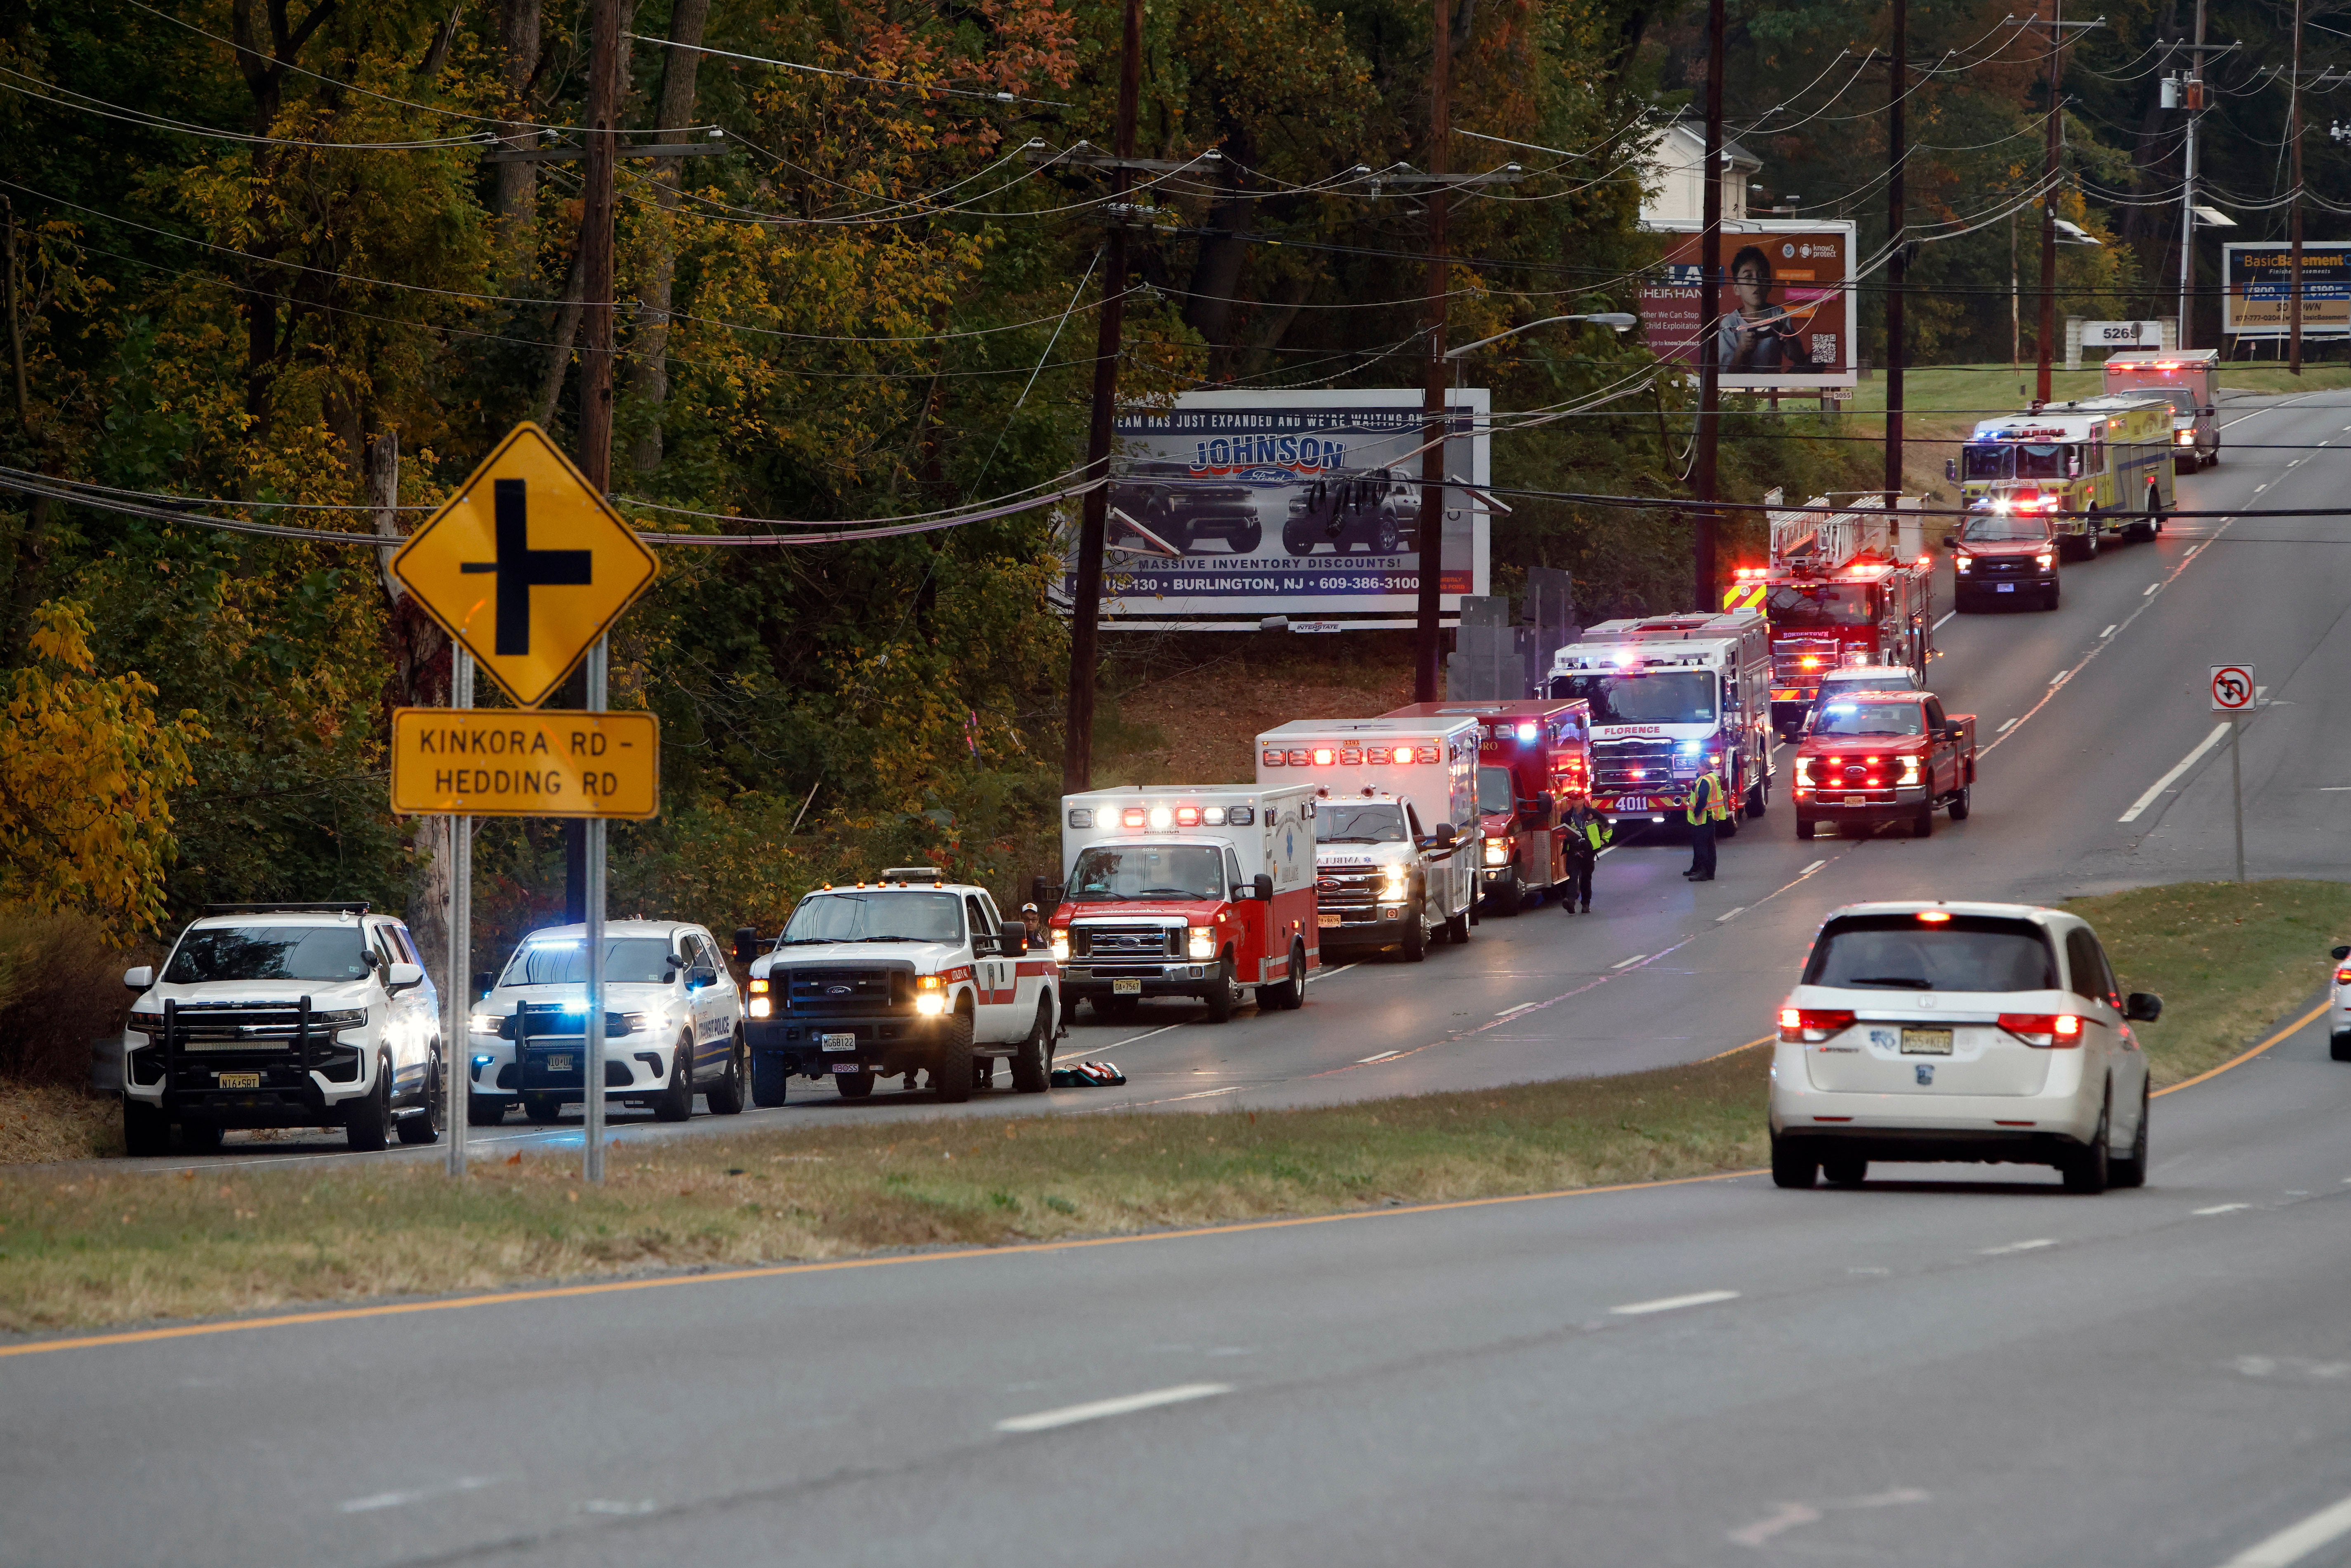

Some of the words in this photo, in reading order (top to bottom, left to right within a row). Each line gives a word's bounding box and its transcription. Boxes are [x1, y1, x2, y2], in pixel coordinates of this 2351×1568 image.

[2244, 254, 2344, 267] BasicBaement
[2310, 285, 2335, 297] $199
[1684, 311, 1699, 320] Stop
[1663, 322, 1702, 331] Exploitation
[1112, 415, 1141, 427] EAM
[1148, 415, 1171, 427] HAS
[1176, 415, 1206, 427] JUST
[1212, 414, 1272, 427] EXPANDED
[1278, 414, 1300, 427] AND
[1307, 414, 1345, 427] WE'RE
[1351, 414, 1402, 427] WAITING
[1409, 414, 1423, 426] ON
[1189, 434, 1346, 472] JOHNSON
[1138, 559, 1206, 569] MASSIVE
[1213, 559, 1300, 569] INVENTORY
[1308, 558, 1401, 568] DISCOUNTS!
[1173, 578, 1279, 591] BURLINGTON,
[1284, 578, 1303, 589] NJ
[1319, 577, 1419, 589] 609-386-3100
[1604, 726, 1660, 735] FLORENCE
[420, 730, 548, 754] KINKORA
[570, 732, 607, 756] RD
[436, 770, 561, 794] HEDDING
[582, 772, 618, 796] RD
[1616, 796, 1648, 811] 4011
[951, 969, 964, 980] UTILITY
[699, 1019, 714, 1040] TRANSIT
[714, 1016, 729, 1036] POLICE
[824, 1038, 853, 1047] MG68122
